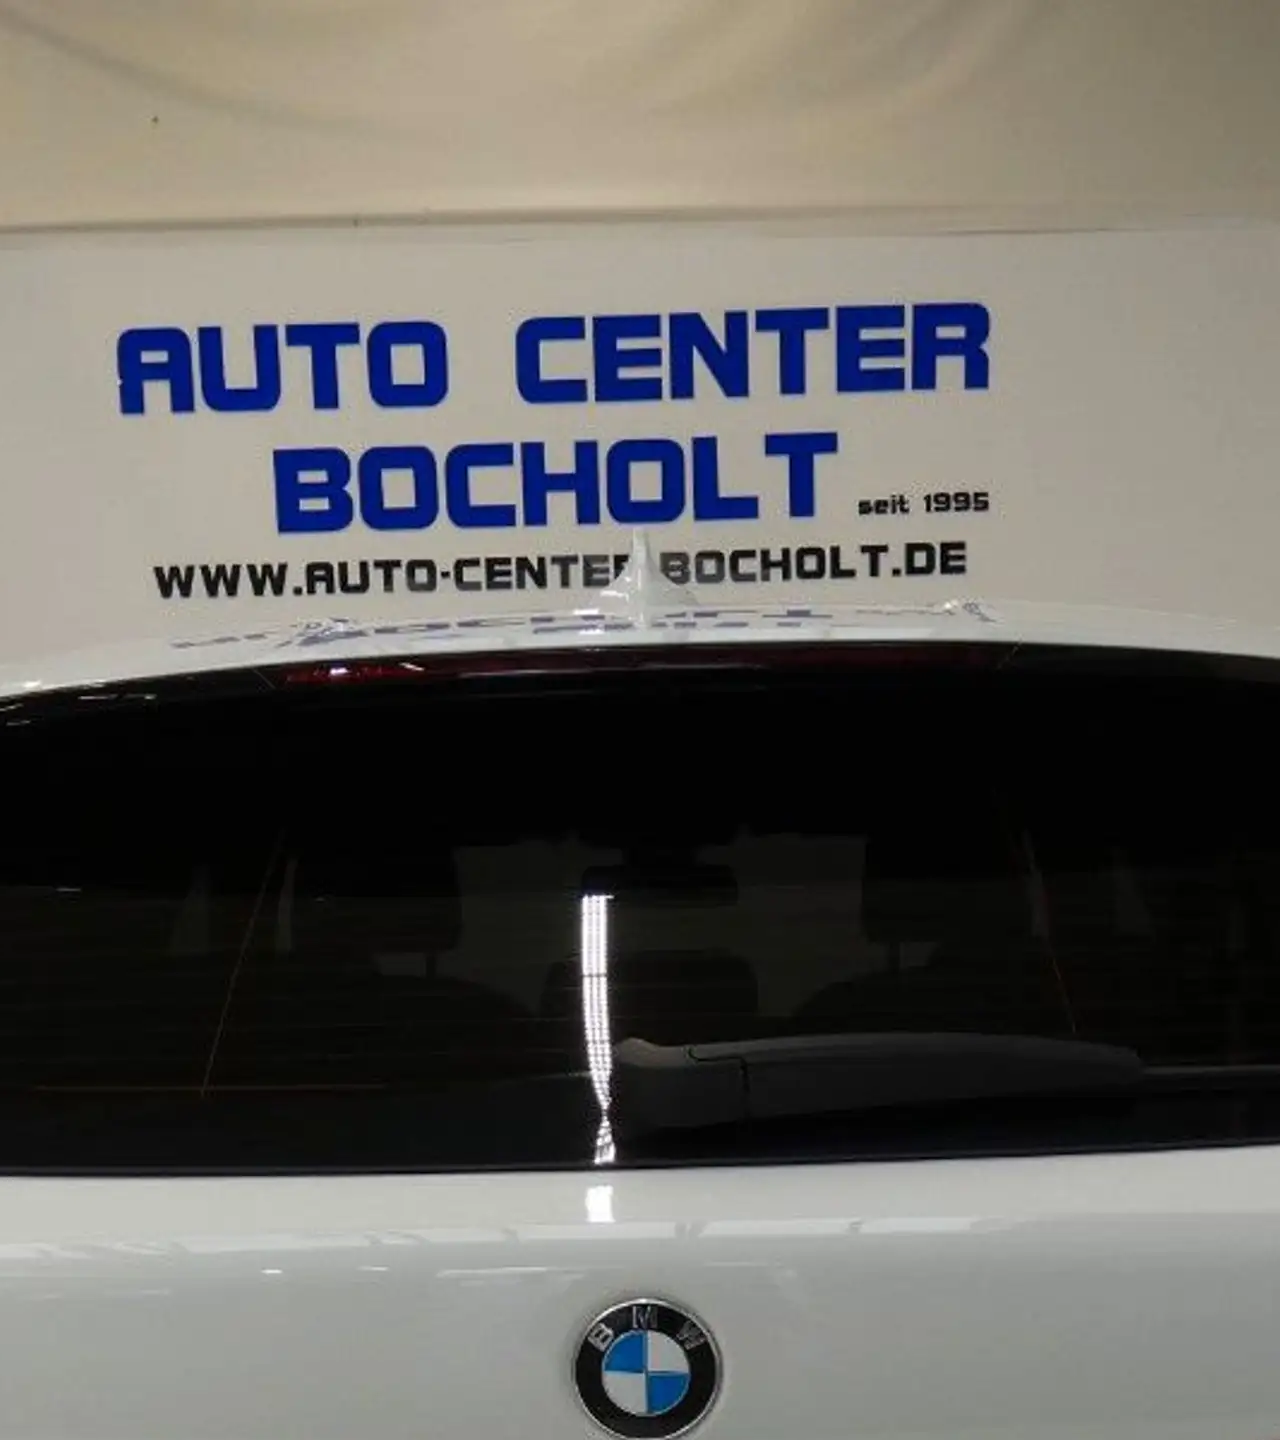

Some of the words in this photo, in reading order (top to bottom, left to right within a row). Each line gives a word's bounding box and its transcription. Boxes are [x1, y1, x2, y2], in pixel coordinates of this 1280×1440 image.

[117, 320, 449, 415] AUTO
[515, 303, 990, 405] CENTER
[273, 432, 838, 534] BOCHOLT
[858, 494, 910, 516] seit
[923, 491, 990, 513] 1995
[153, 541, 967, 599] WWW.AUTO-CENTEBOCHOLT.DE
[588, 1305, 707, 1352] BMW
